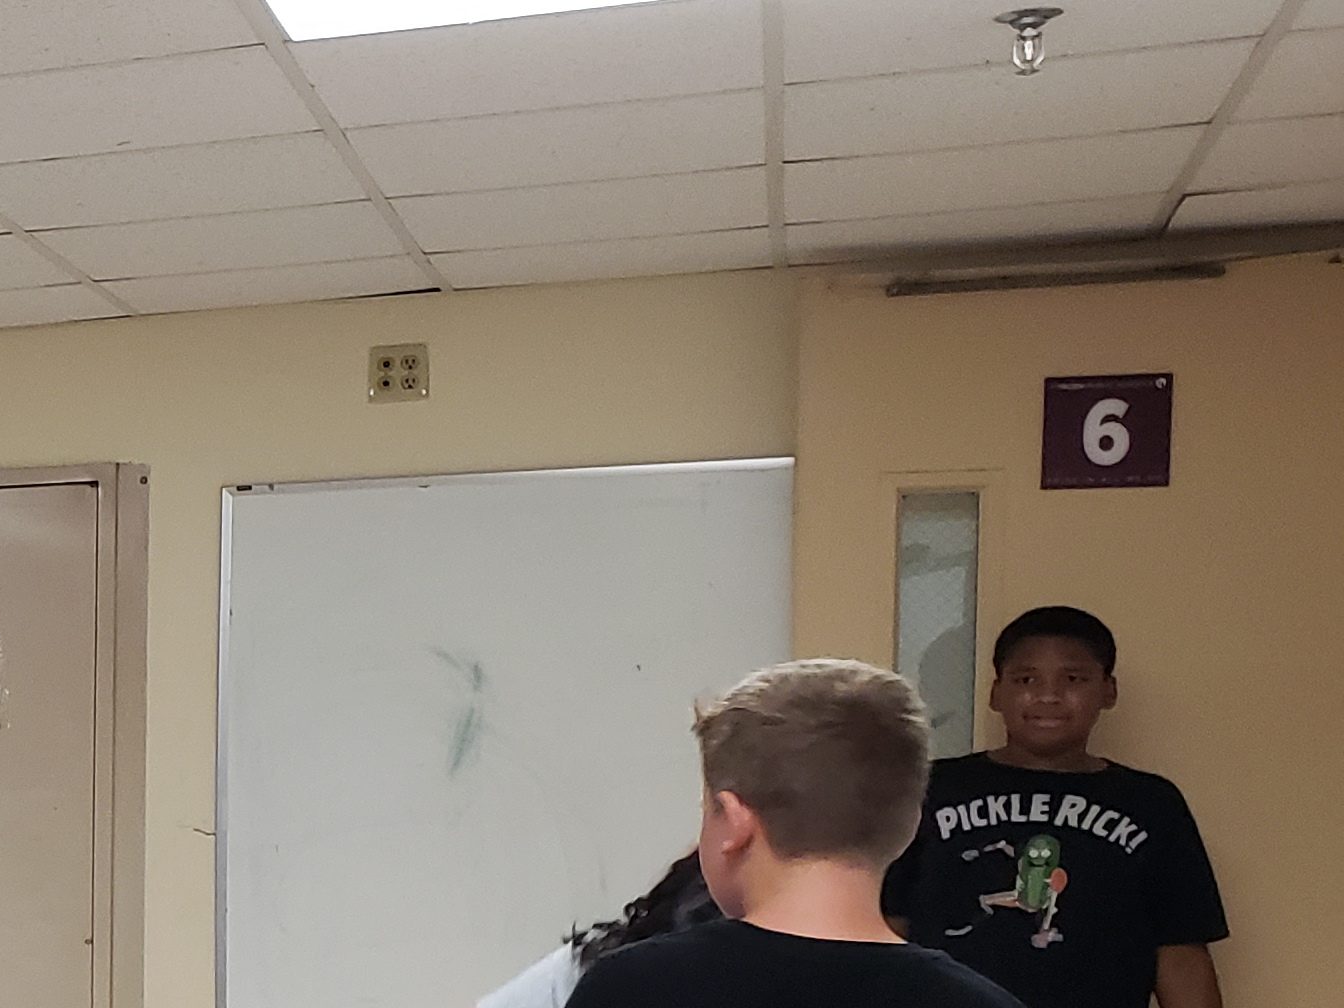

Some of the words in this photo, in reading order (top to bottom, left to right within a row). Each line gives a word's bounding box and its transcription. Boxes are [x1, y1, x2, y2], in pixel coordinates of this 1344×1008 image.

[1082, 397, 1131, 467] 6
[935, 793, 1052, 841] PICKLE
[1054, 794, 1149, 855] RICK!
